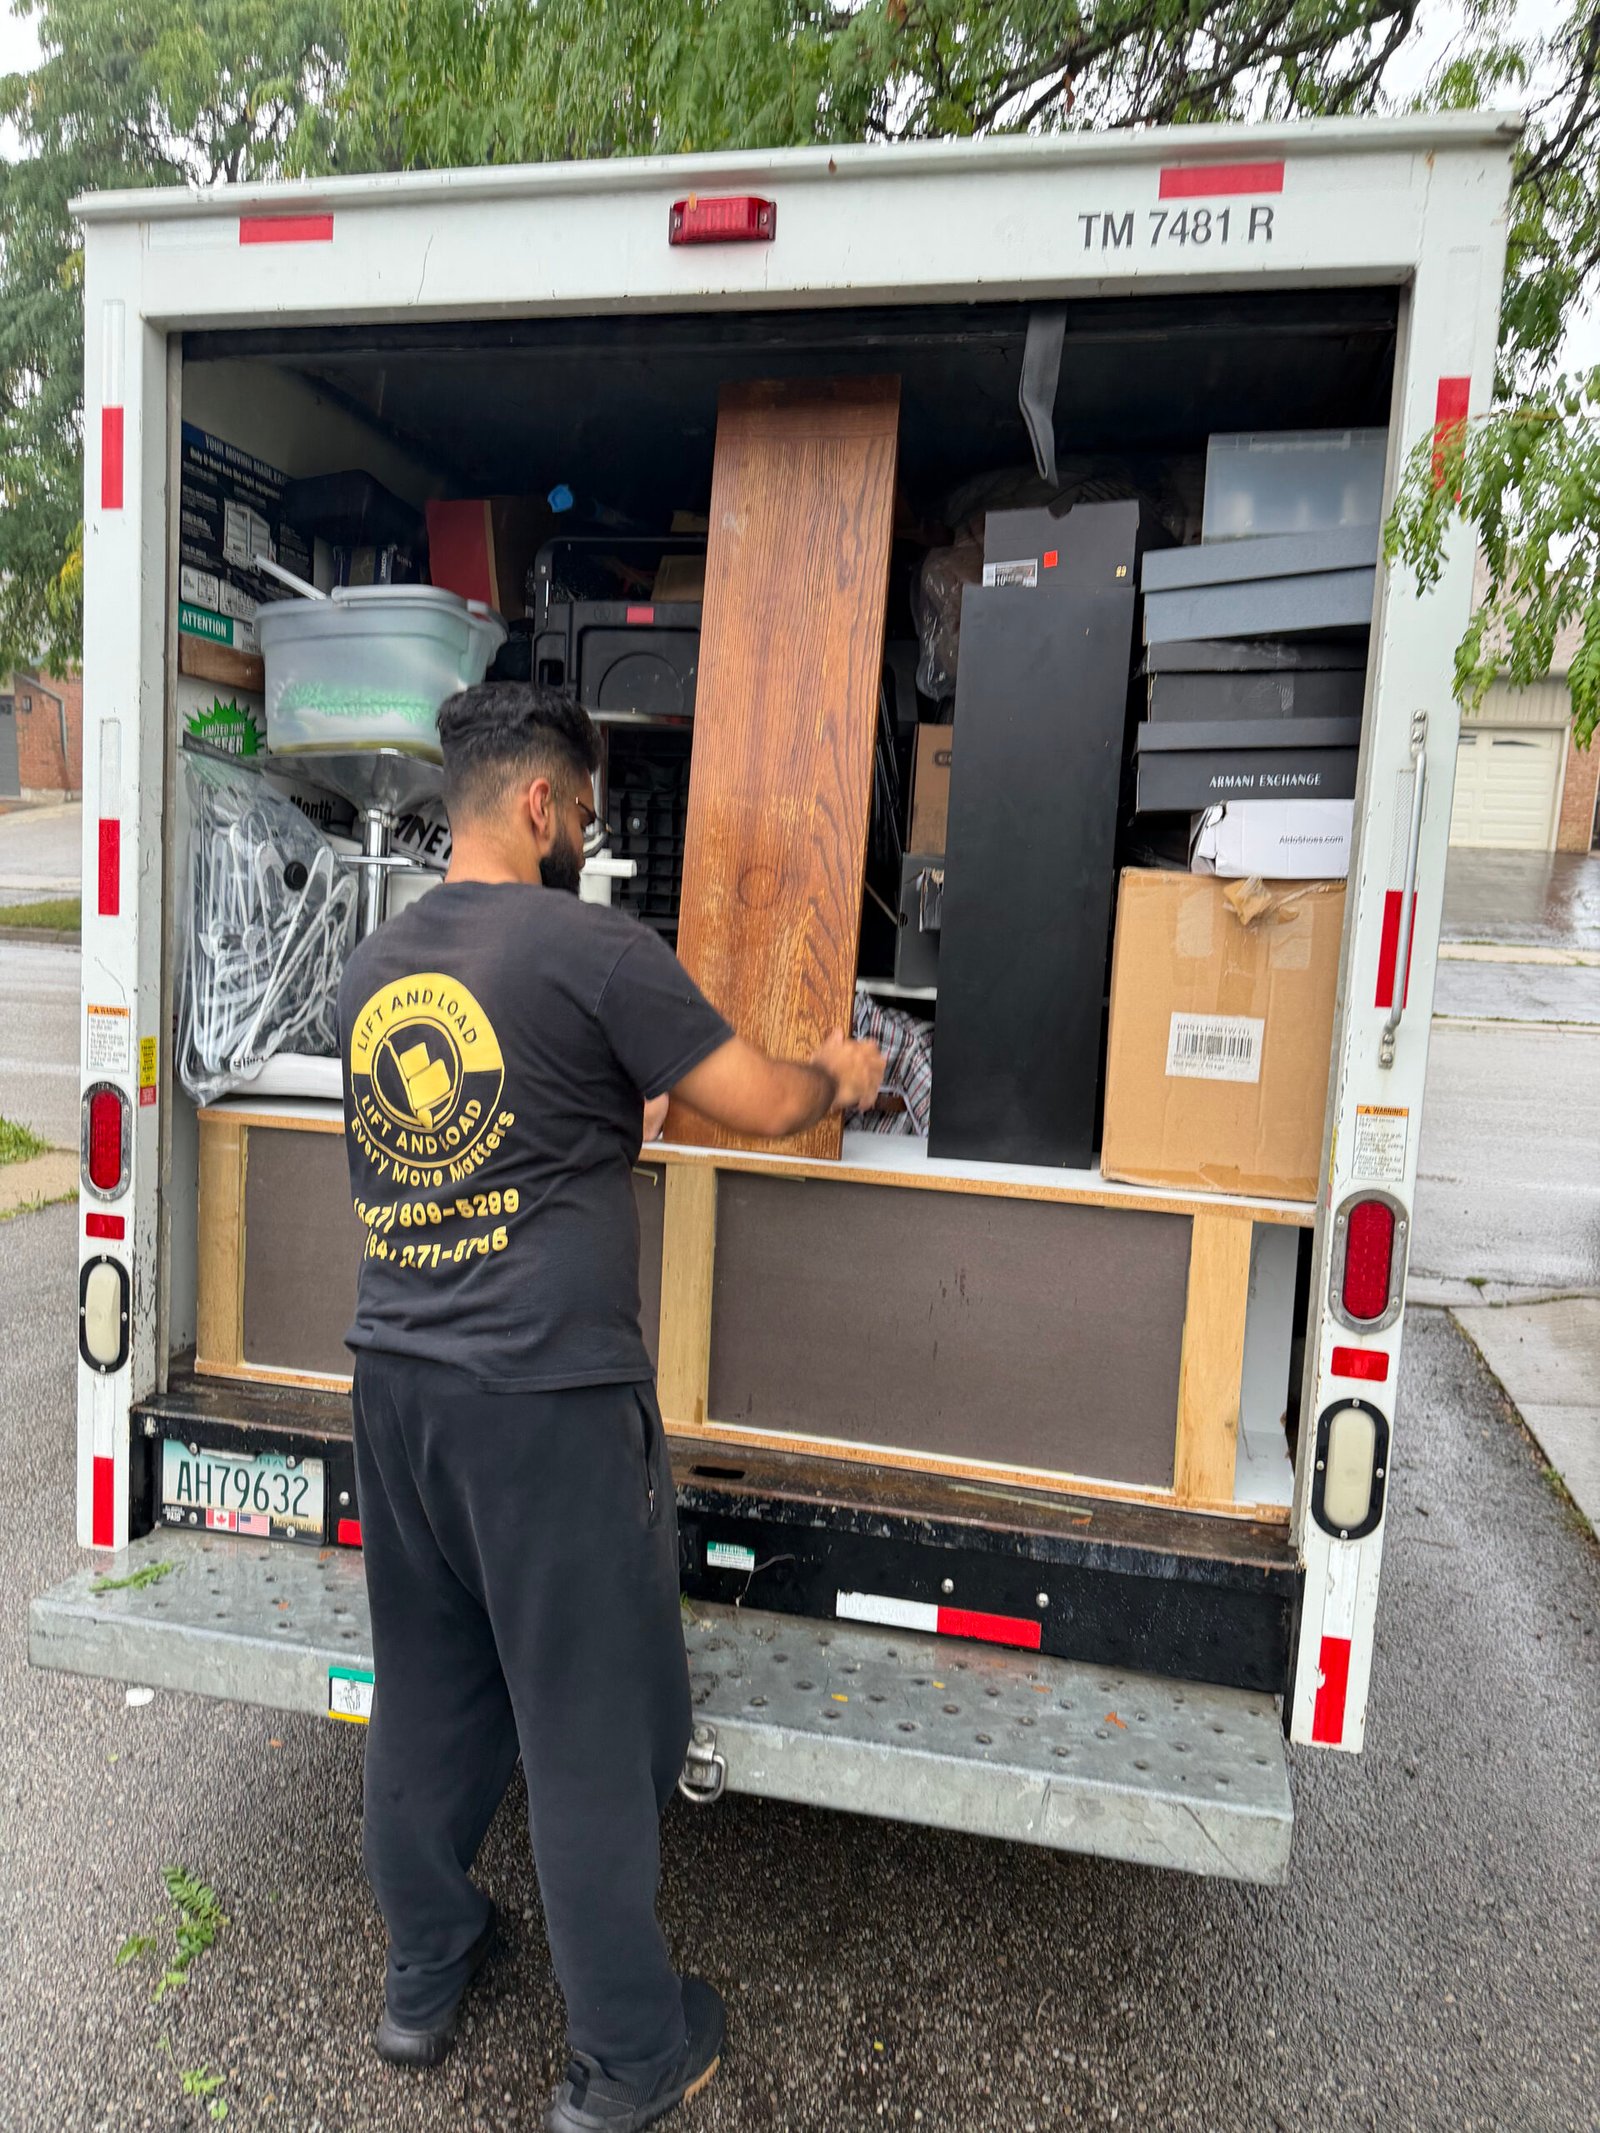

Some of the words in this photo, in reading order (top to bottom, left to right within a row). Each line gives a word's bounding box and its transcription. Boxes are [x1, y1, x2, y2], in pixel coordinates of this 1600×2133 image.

[1078, 211, 1134, 249] TM
[1149, 208, 1232, 247] 7481
[1249, 206, 1274, 243] R
[181, 608, 227, 639] ATTENTION
[201, 719, 229, 738] LIMITED
[231, 721, 246, 736] TIME
[1209, 774, 1255, 789] ARMANI
[1259, 772, 1322, 787] EXCHANGE
[358, 1005, 383, 1051] LIFT
[392, 989, 433, 1012] AND
[437, 993, 477, 1044] LOAD
[362, 1095, 391, 1136] LIFT
[396, 1131, 437, 1154] AND
[438, 1099, 482, 1152] LOAD
[1373, 1106, 1403, 1117] WARNING
[351, 1116, 389, 1175] Every
[392, 1161, 443, 1188] Move
[449, 1111, 515, 1183] Matters
[176, 1459, 309, 1518] AH79632
